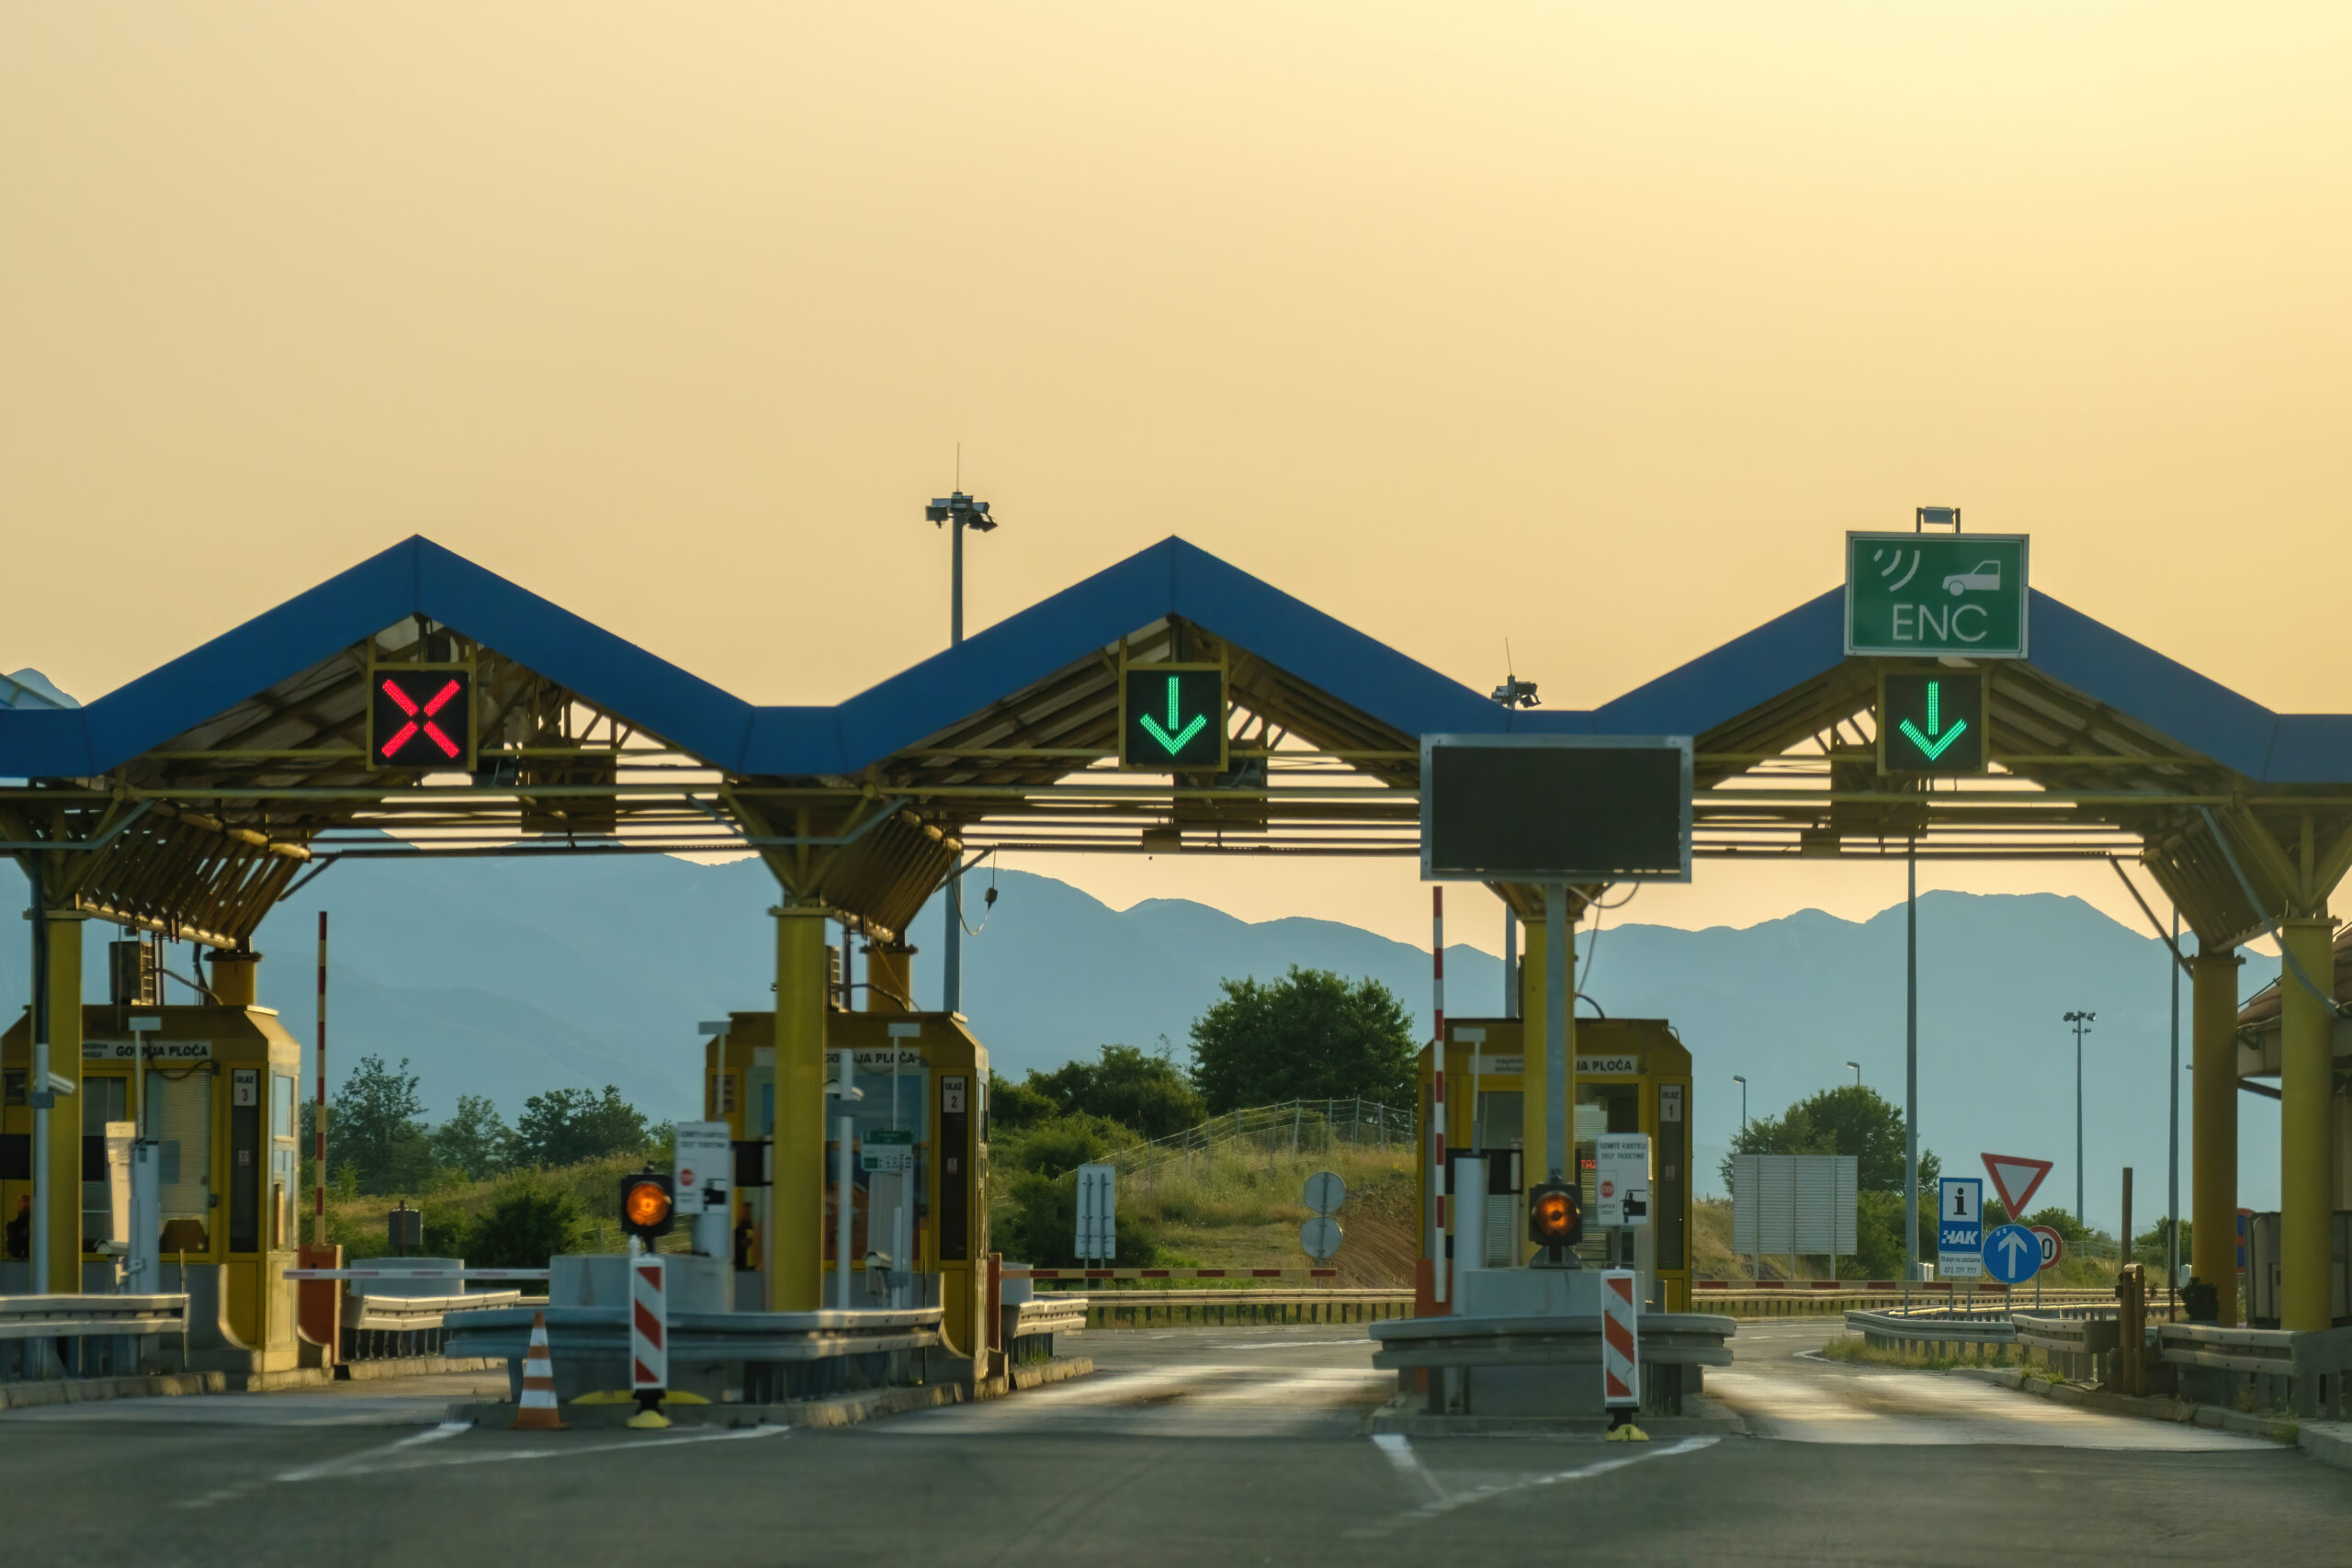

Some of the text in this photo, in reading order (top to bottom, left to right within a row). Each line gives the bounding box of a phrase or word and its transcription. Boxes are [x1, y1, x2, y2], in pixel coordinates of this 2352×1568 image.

[1893, 604, 1988, 642] ENC
[116, 1045, 165, 1056] GONJA
[1592, 1058, 1632, 1071] PLOČA
[944, 1082, 963, 1090] ULAZ
[951, 1095, 958, 1109] 2
[1941, 1230, 1979, 1245] HAK
[2042, 1238, 2053, 1259] 0
